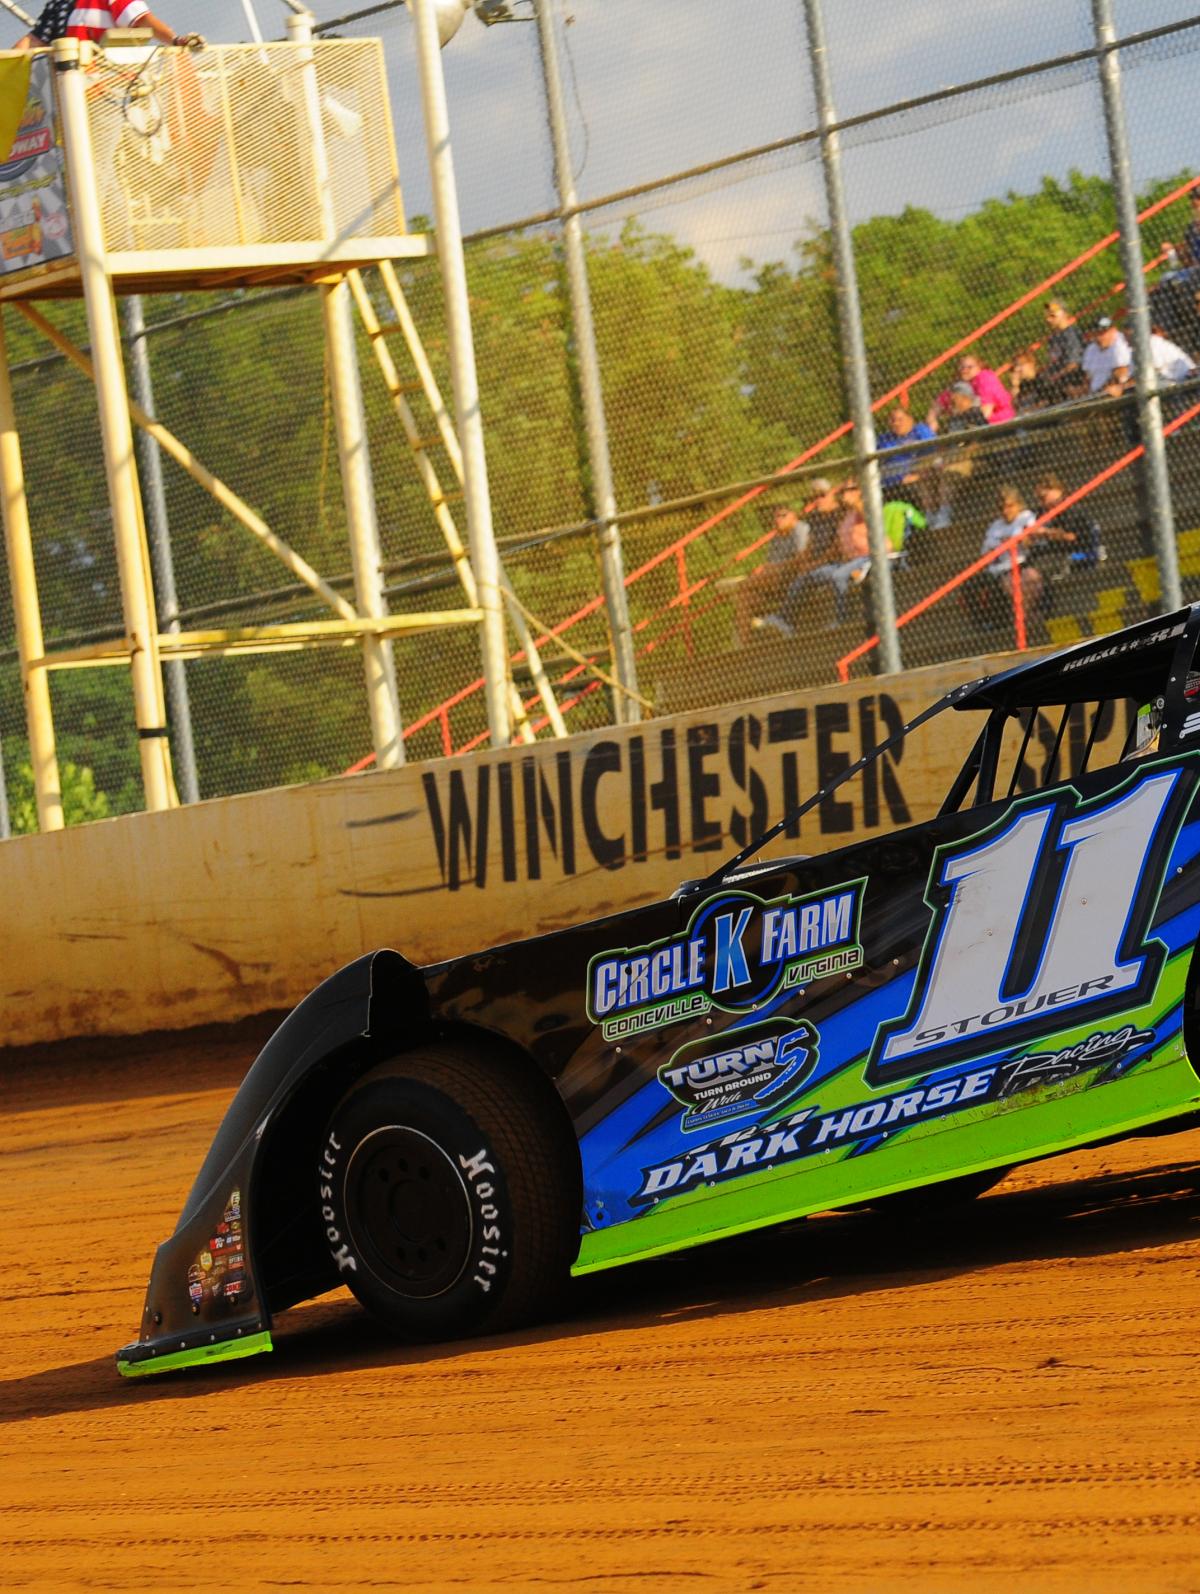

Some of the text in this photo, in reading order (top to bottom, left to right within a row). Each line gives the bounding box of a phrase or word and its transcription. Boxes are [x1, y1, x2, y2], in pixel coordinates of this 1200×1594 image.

[421, 693, 912, 892] WINCHESTER
[595, 894, 856, 1014] CIRCLE K FARM
[880, 768, 1181, 1062] 11
[640, 1124, 808, 1196] DARK
[811, 1068, 998, 1145] HORSE
[999, 1026, 1153, 1097] Racing
[664, 1026, 810, 1100] TURN 5
[693, 1072, 773, 1101] TURN AROUND
[459, 1148, 508, 1292] Hoosier
